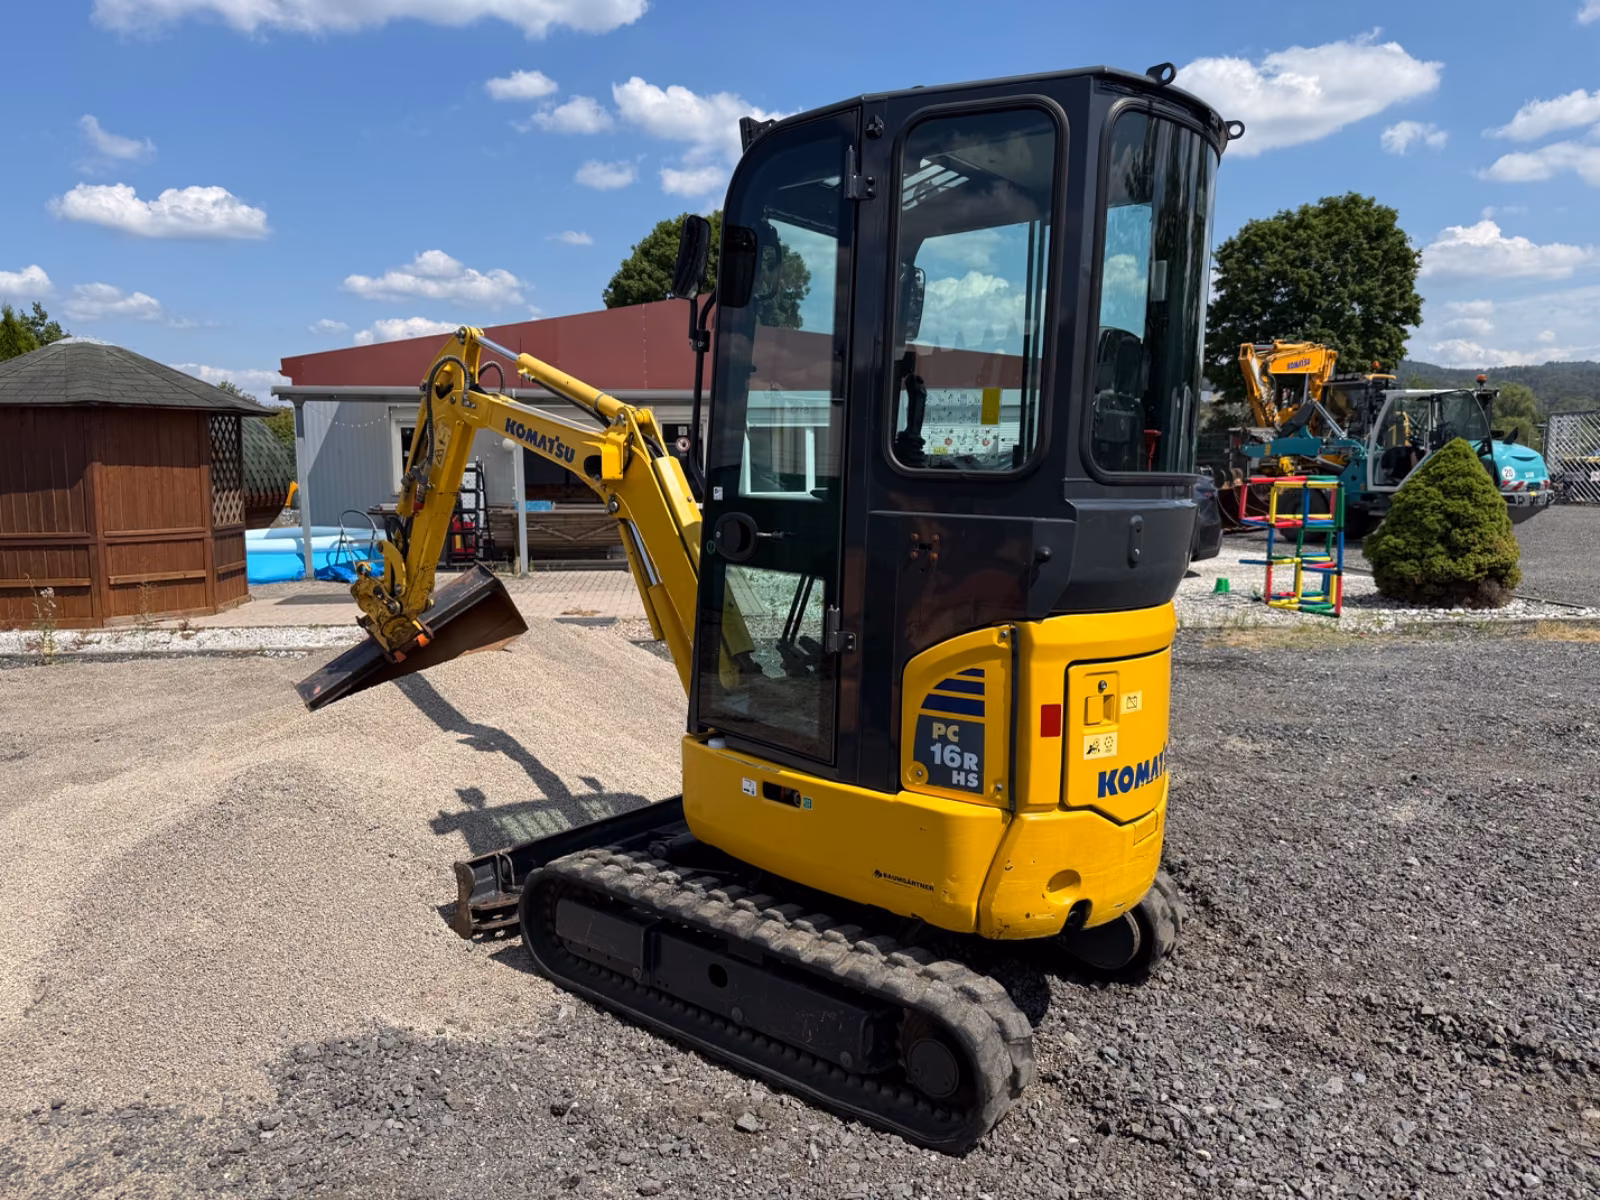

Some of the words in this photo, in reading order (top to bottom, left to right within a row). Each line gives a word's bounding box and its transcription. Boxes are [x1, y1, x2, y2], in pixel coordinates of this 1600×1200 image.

[504, 417, 576, 463] KOMATSU
[1504, 468, 1514, 478] 20
[932, 721, 959, 743] PC
[930, 742, 979, 771] 16R
[951, 769, 979, 788] HS
[1097, 745, 1166, 799] KOMAT
